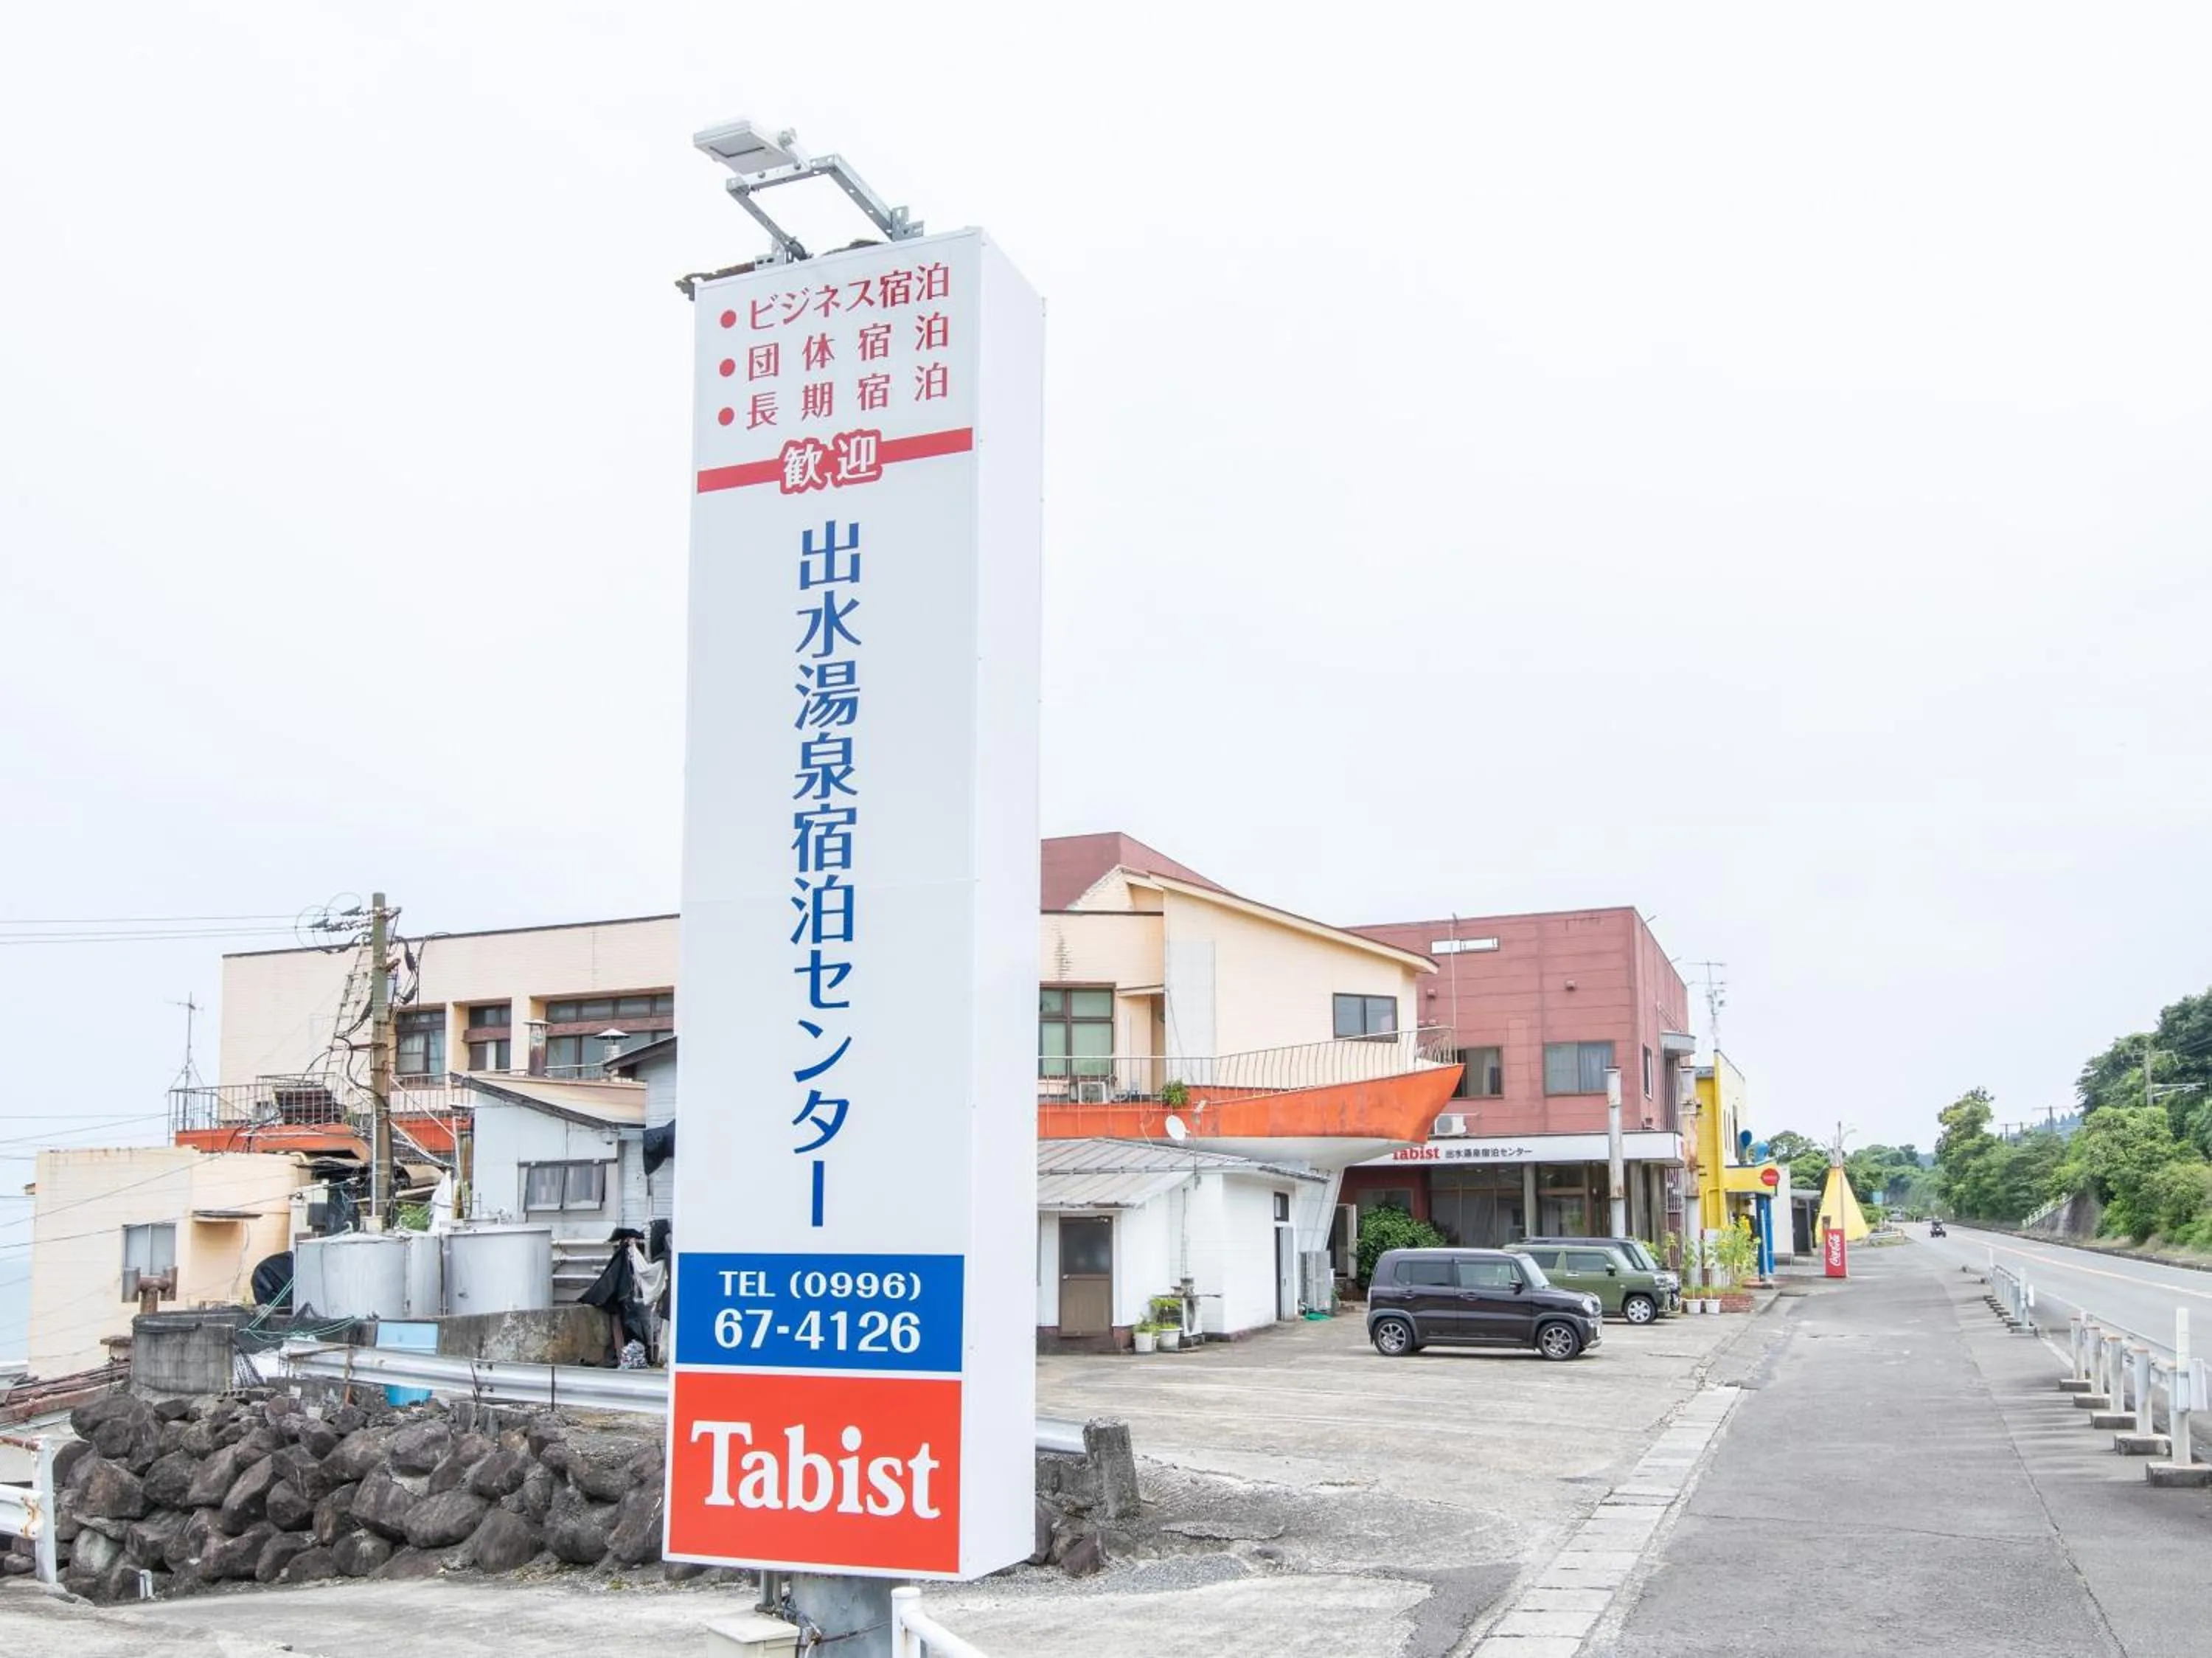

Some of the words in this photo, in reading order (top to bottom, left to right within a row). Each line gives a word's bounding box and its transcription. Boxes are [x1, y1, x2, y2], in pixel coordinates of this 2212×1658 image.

[749, 262, 950, 330] ビジネス宿泊
[747, 311, 950, 381] 団体宿泊
[745, 361, 949, 430] 長期宿泊
[784, 435, 877, 487] 歓迎
[790, 519, 862, 1228] 出水湯泉宿泊センター
[717, 1271, 776, 1297] TEL
[790, 1271, 922, 1301] (0996)
[714, 1308, 921, 1353] 67-4126
[690, 1420, 942, 1519] Tabist
